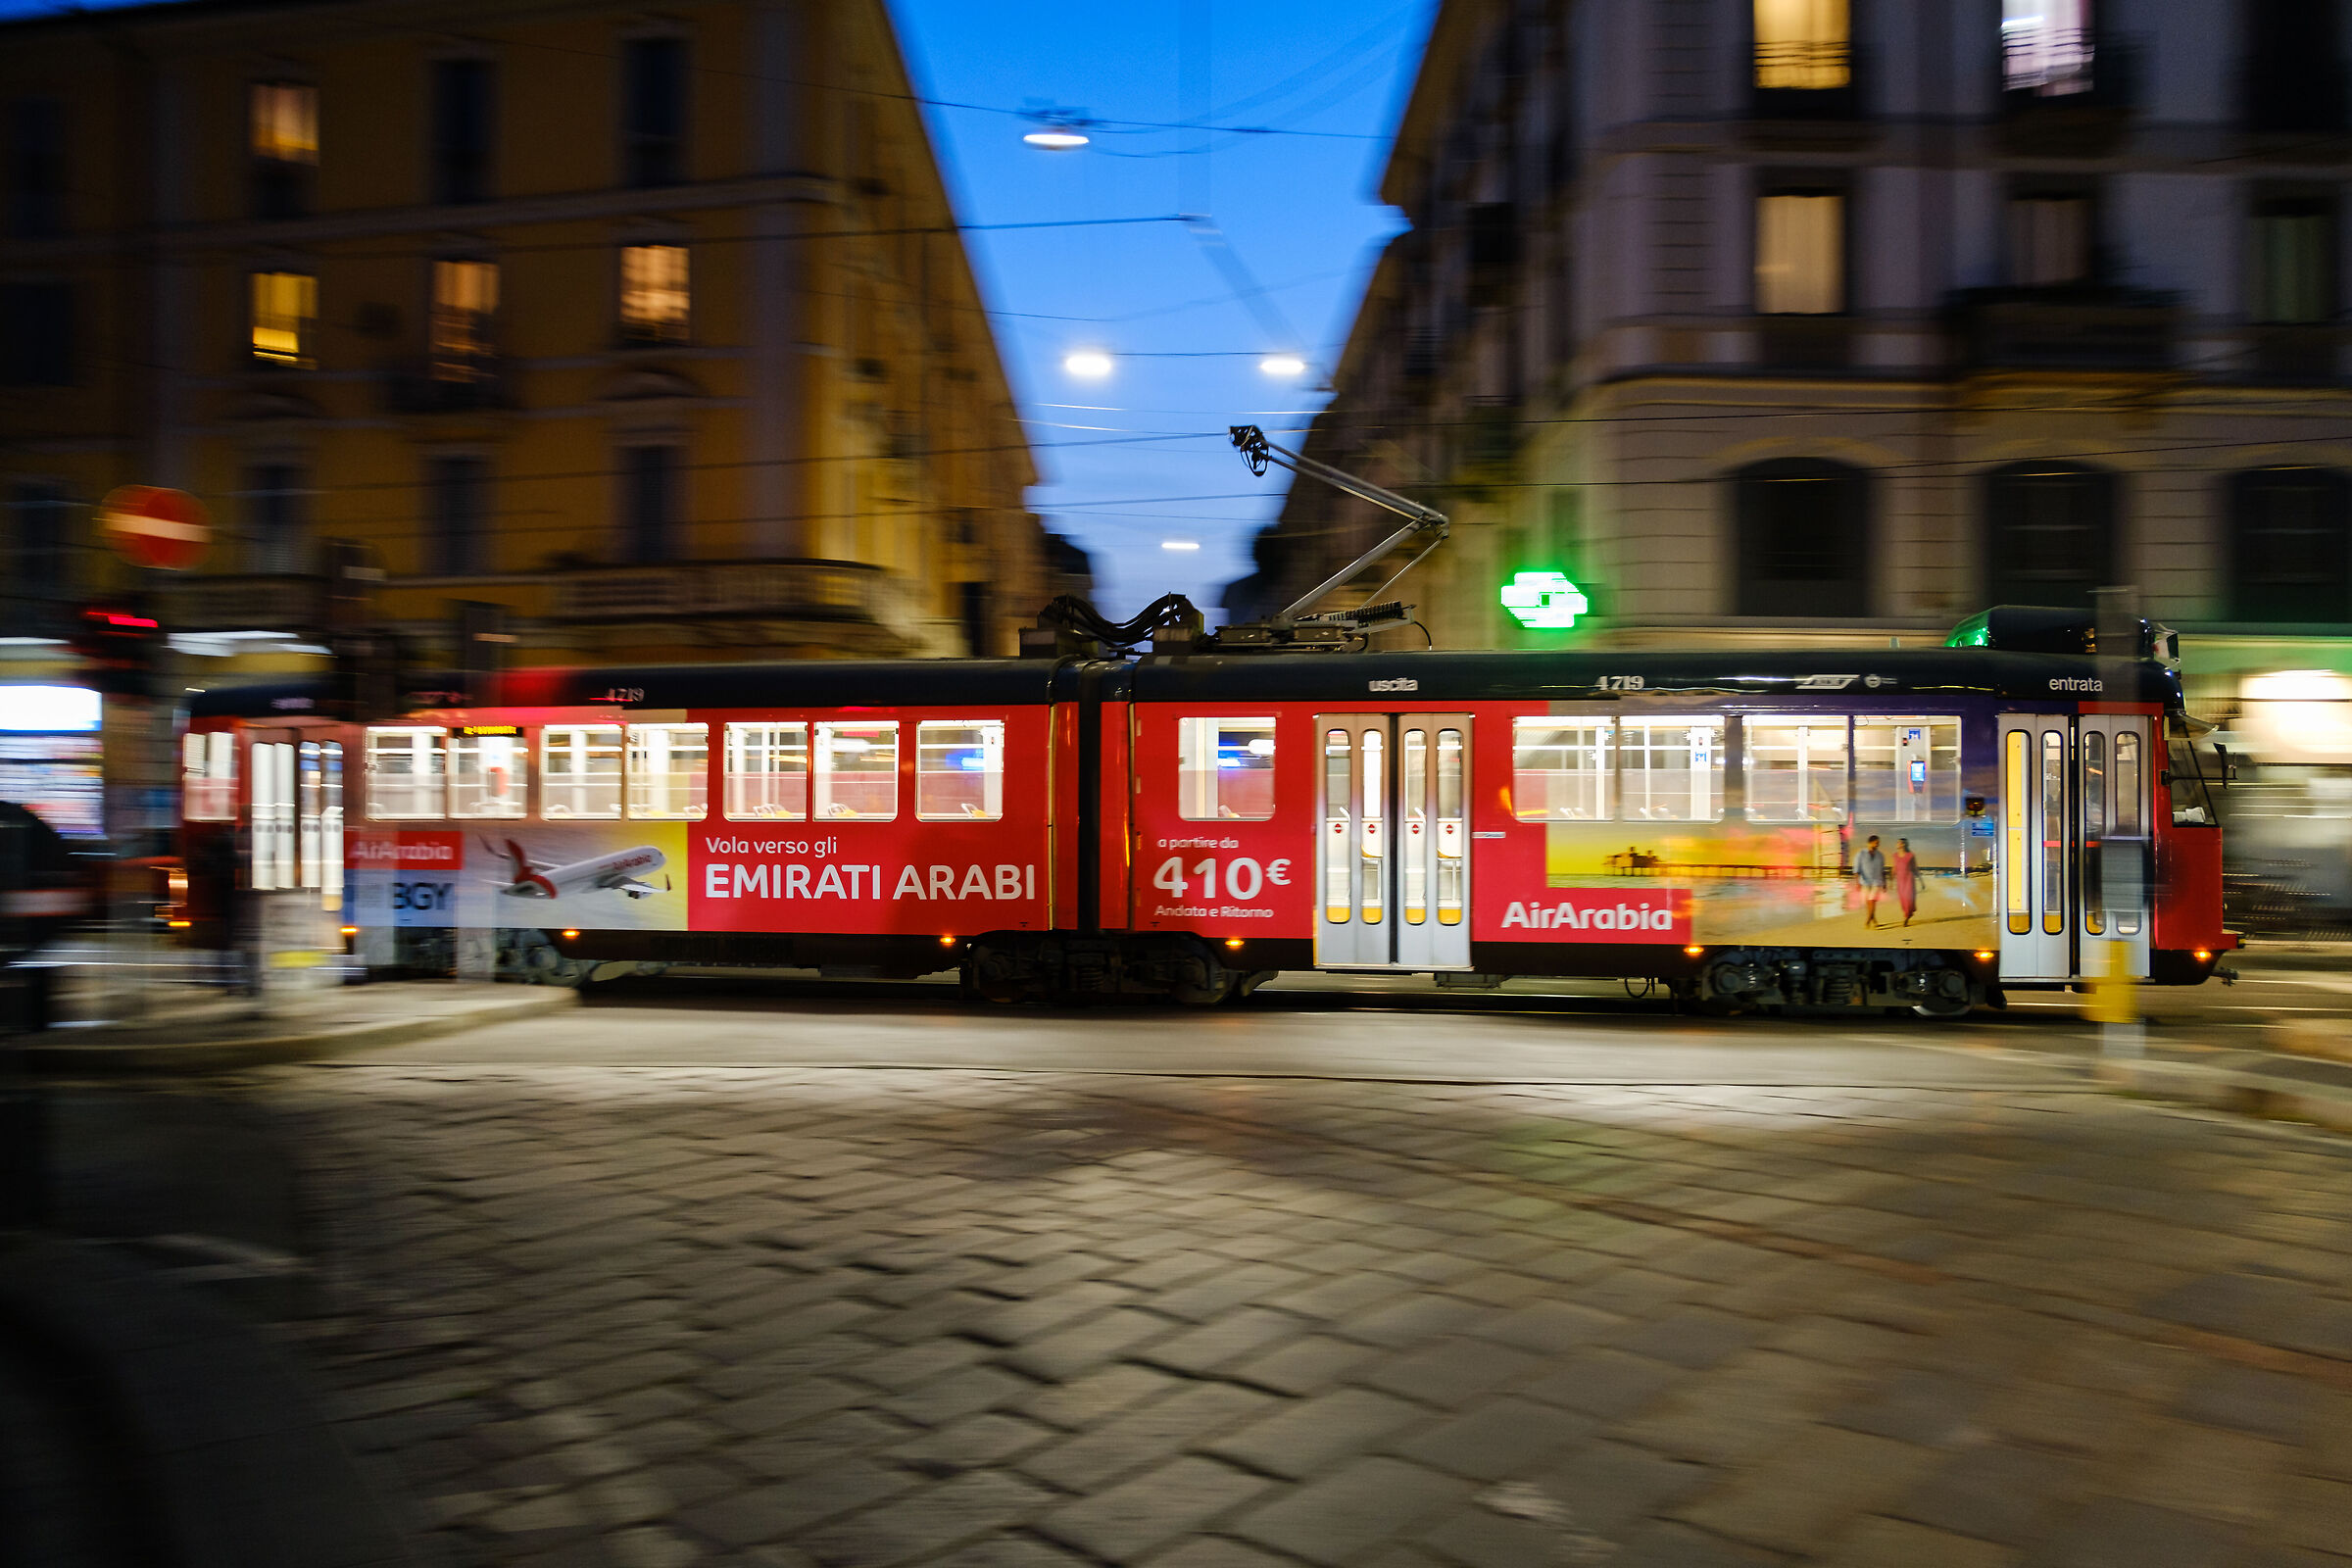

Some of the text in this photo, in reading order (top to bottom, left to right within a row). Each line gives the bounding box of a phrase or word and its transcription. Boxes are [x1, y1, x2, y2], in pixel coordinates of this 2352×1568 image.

[1368, 677, 1418, 692] uscita
[1594, 675, 1645, 690] 4719
[2049, 676, 2103, 692] entrata
[706, 836, 837, 858] Vola verso gli
[1157, 836, 1240, 851] a partire da
[706, 863, 1035, 901] EMIRATI ARABI
[1152, 857, 1293, 901] 410€
[1154, 905, 1274, 918] Andata e Ritorno
[1500, 902, 1673, 930] AirArabia
